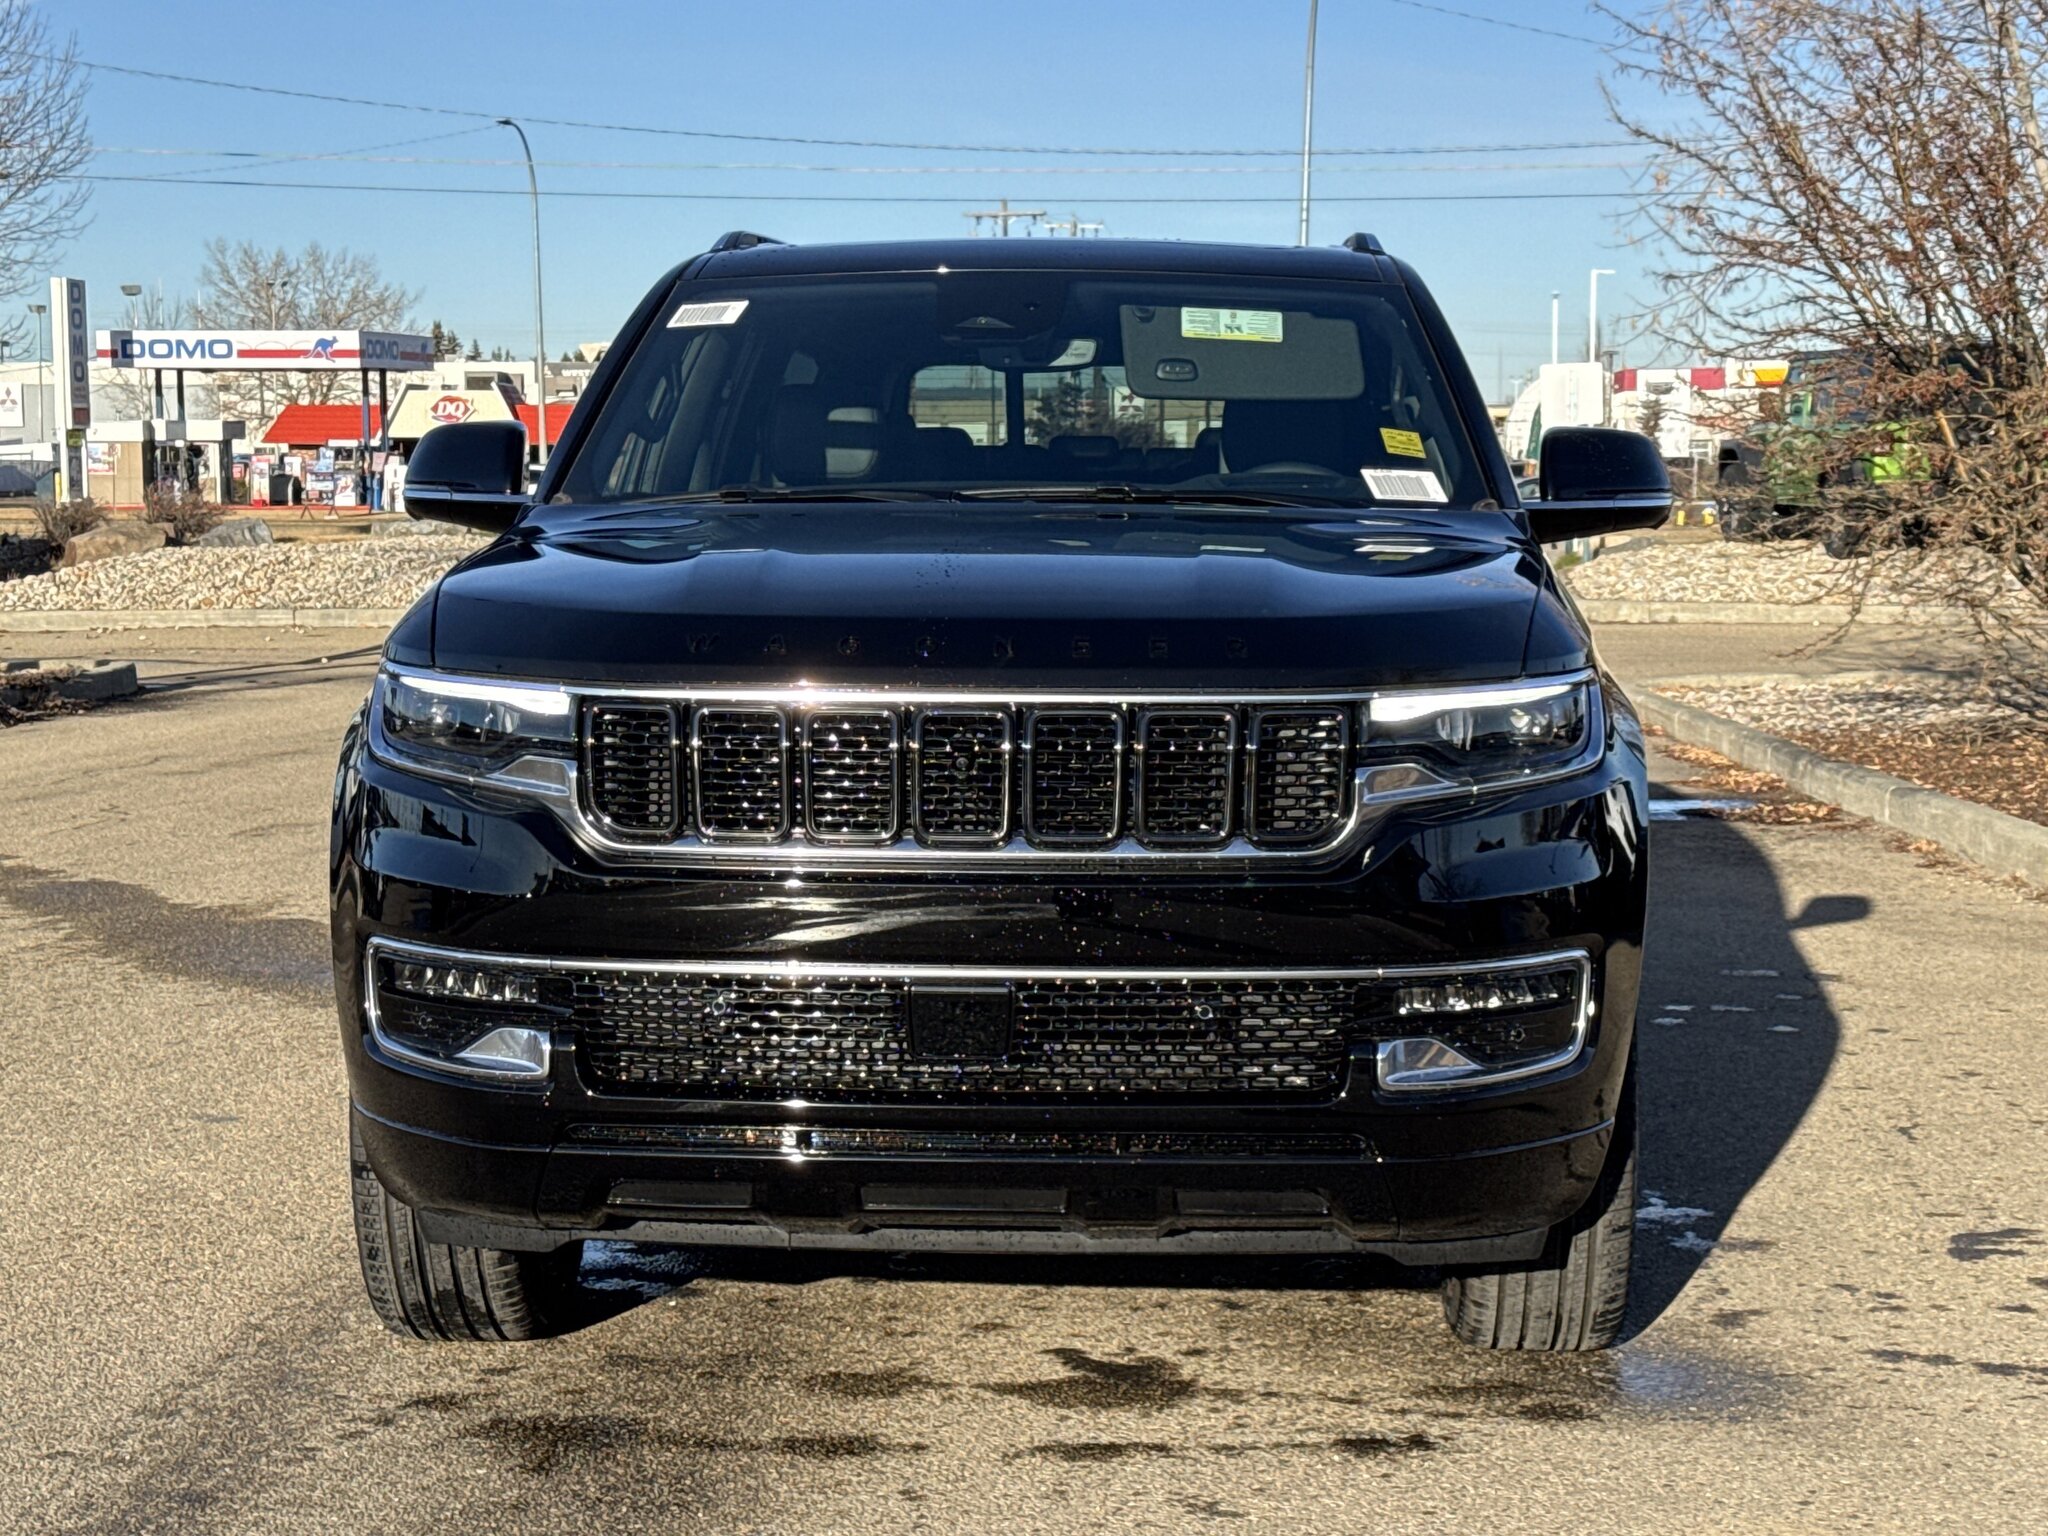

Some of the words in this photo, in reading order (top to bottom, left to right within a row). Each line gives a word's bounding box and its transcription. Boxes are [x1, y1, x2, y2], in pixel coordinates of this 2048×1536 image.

[70, 282, 85, 382] DOMO
[120, 339, 233, 359] DOMO
[366, 339, 399, 360] DOMO
[436, 400, 466, 417] DQ
[685, 633, 1248, 658] WAGONEER
